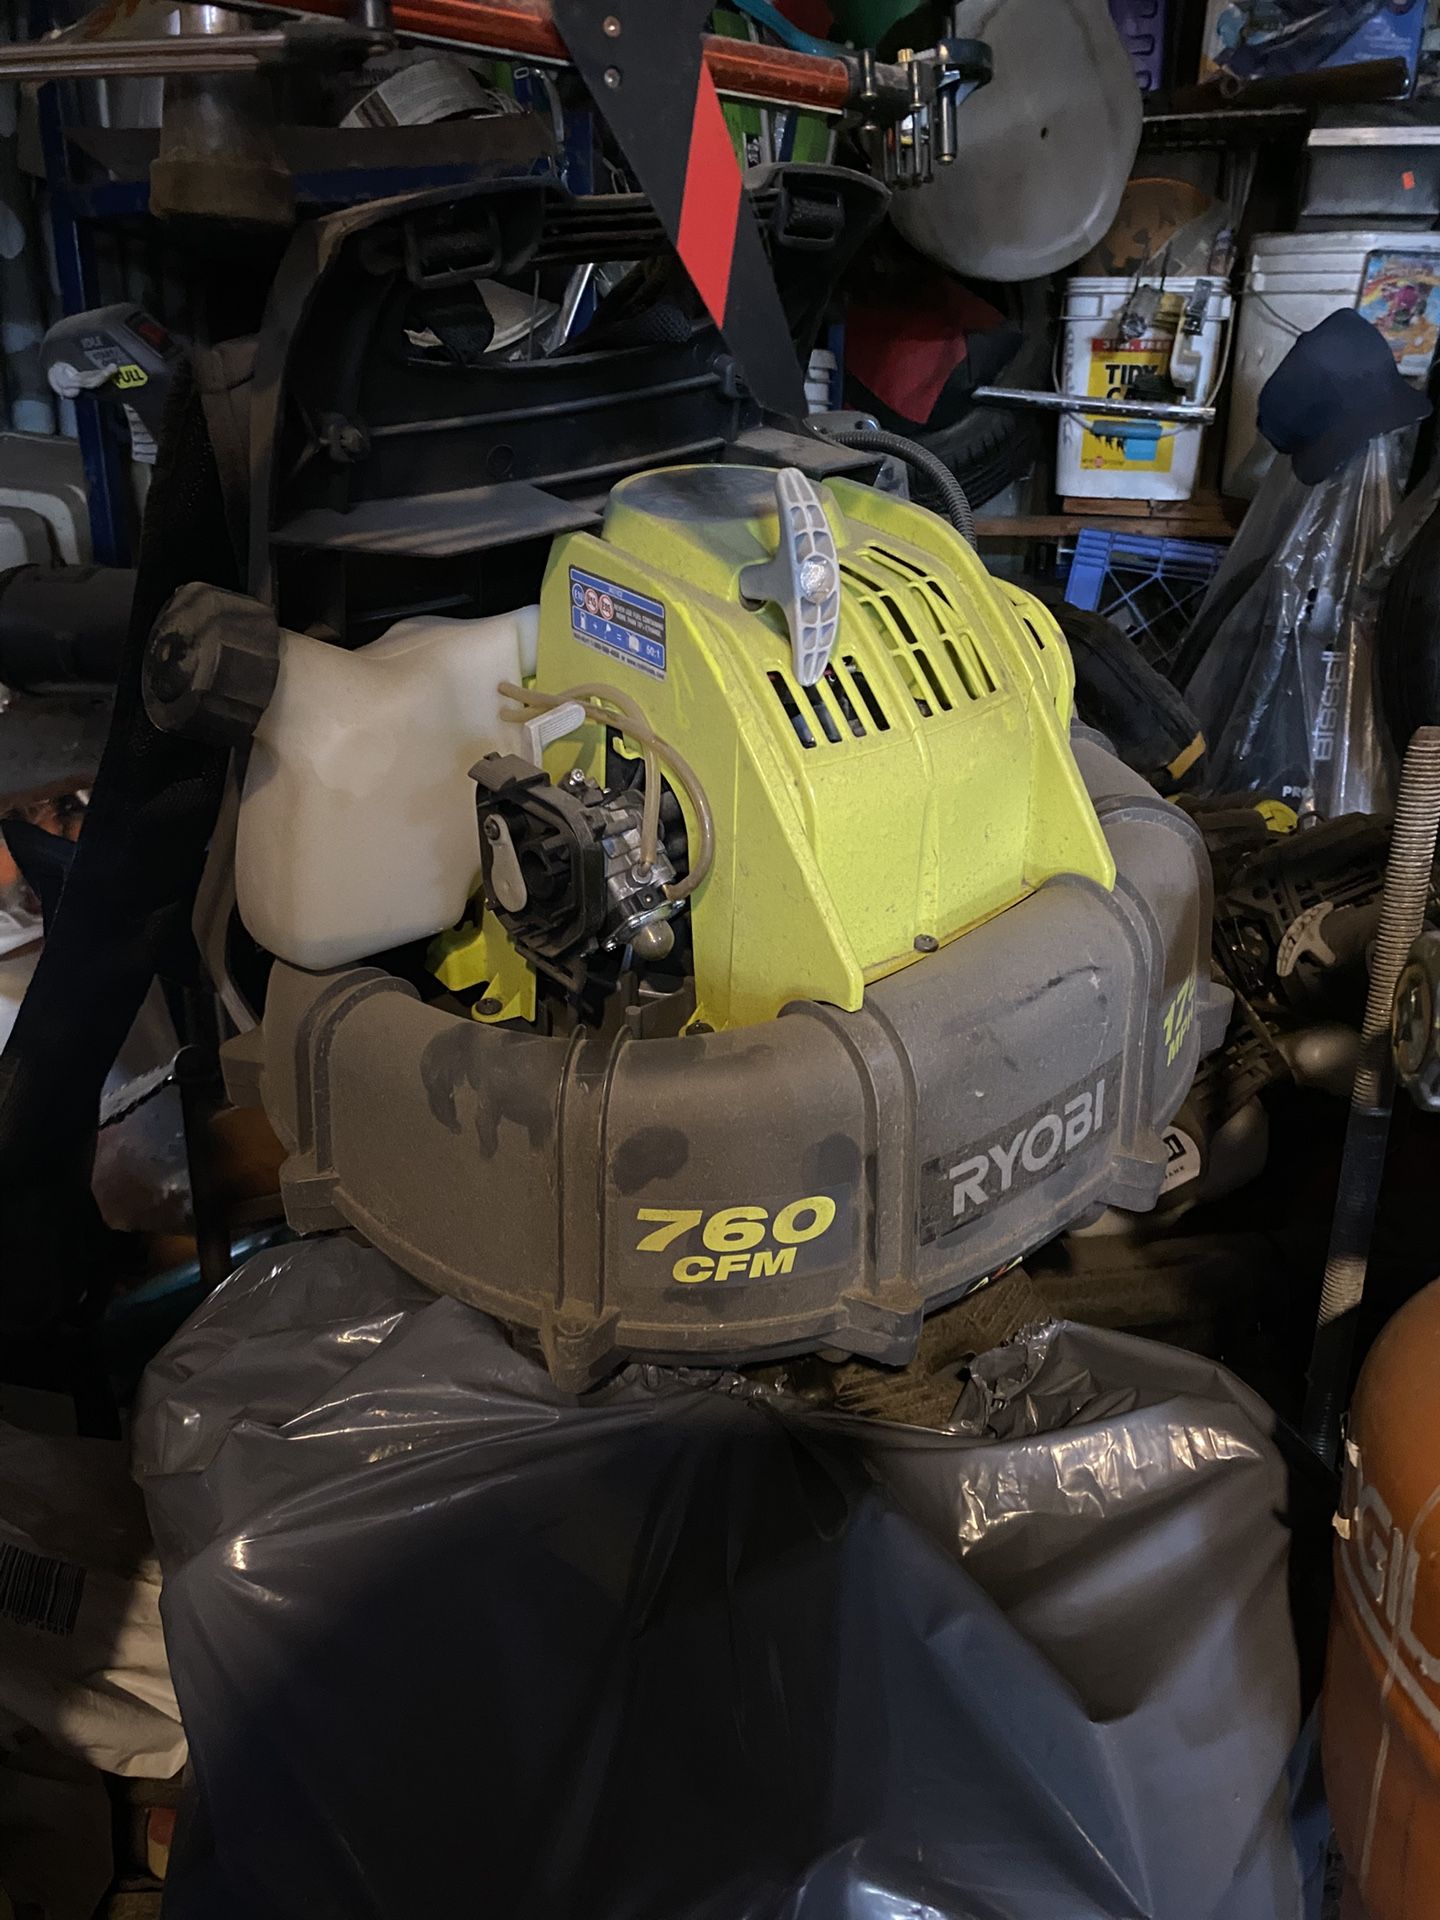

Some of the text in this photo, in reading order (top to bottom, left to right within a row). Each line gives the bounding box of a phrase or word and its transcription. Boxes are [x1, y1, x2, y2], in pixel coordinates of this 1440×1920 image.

[948, 1078, 1105, 1217] RYOBI
[636, 1195, 837, 1253] 760
[672, 1247, 797, 1283] CFM
